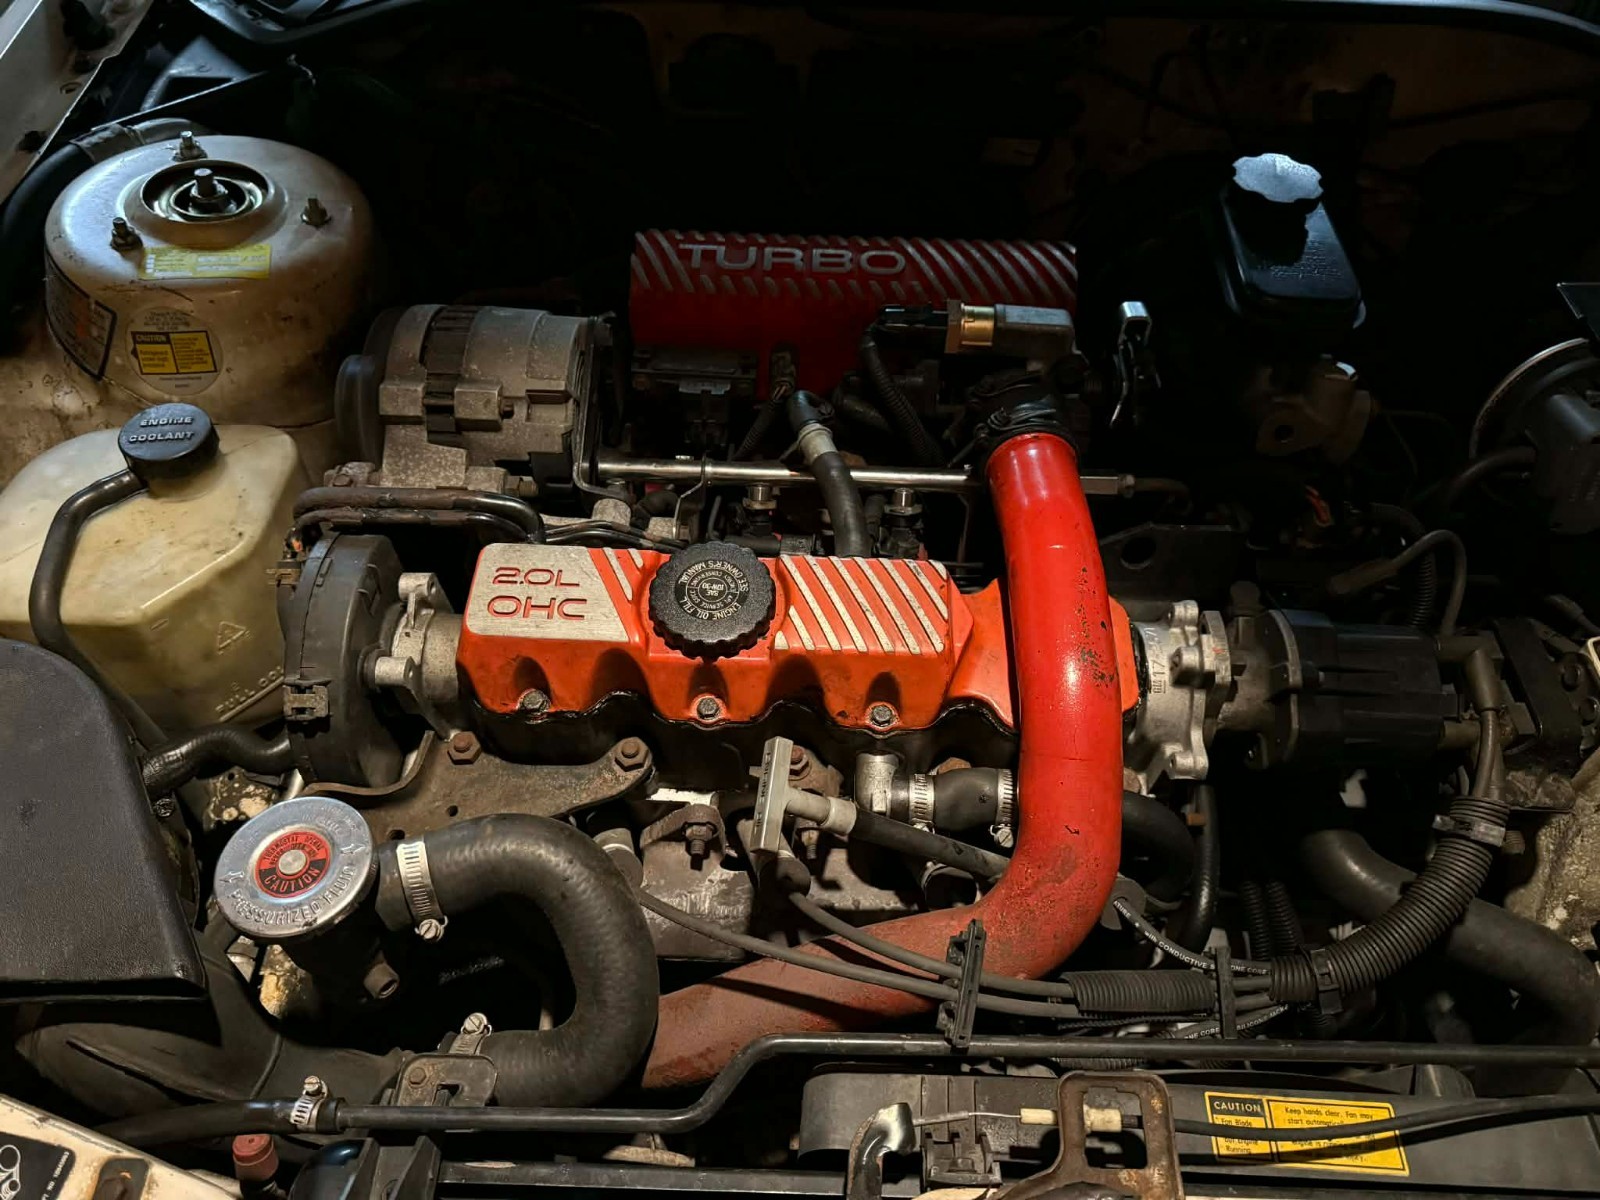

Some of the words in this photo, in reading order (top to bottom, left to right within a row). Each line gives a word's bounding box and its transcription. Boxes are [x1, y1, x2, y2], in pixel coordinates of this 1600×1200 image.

[678, 243, 906, 275] TURBO
[139, 416, 194, 428] ENGINE
[127, 431, 195, 444] COOLANT
[492, 566, 580, 588] 2.0L
[678, 562, 706, 584] MANUAL
[707, 560, 743, 579] OWNER'S
[738, 577, 749, 592] SEE
[487, 595, 588, 621] OHC
[679, 596, 696, 614] FILL
[695, 608, 709, 620] OIL
[712, 602, 742, 620] ENGINE
[264, 867, 320, 893] CAUTION
[229, 888, 321, 926] PRESSURIZED
[322, 865, 355, 905] FLUID
[1158, 941, 1208, 969] CONDUCTIVE
[1200, 1027, 1220, 1037] CORE
[1213, 1101, 1262, 1113] CAUTION
[1284, 1105, 1302, 1115] Keep
[1303, 1107, 1323, 1115] hands
[1221, 1118, 1233, 1126] Fan
[1235, 1119, 1253, 1127] Blade
